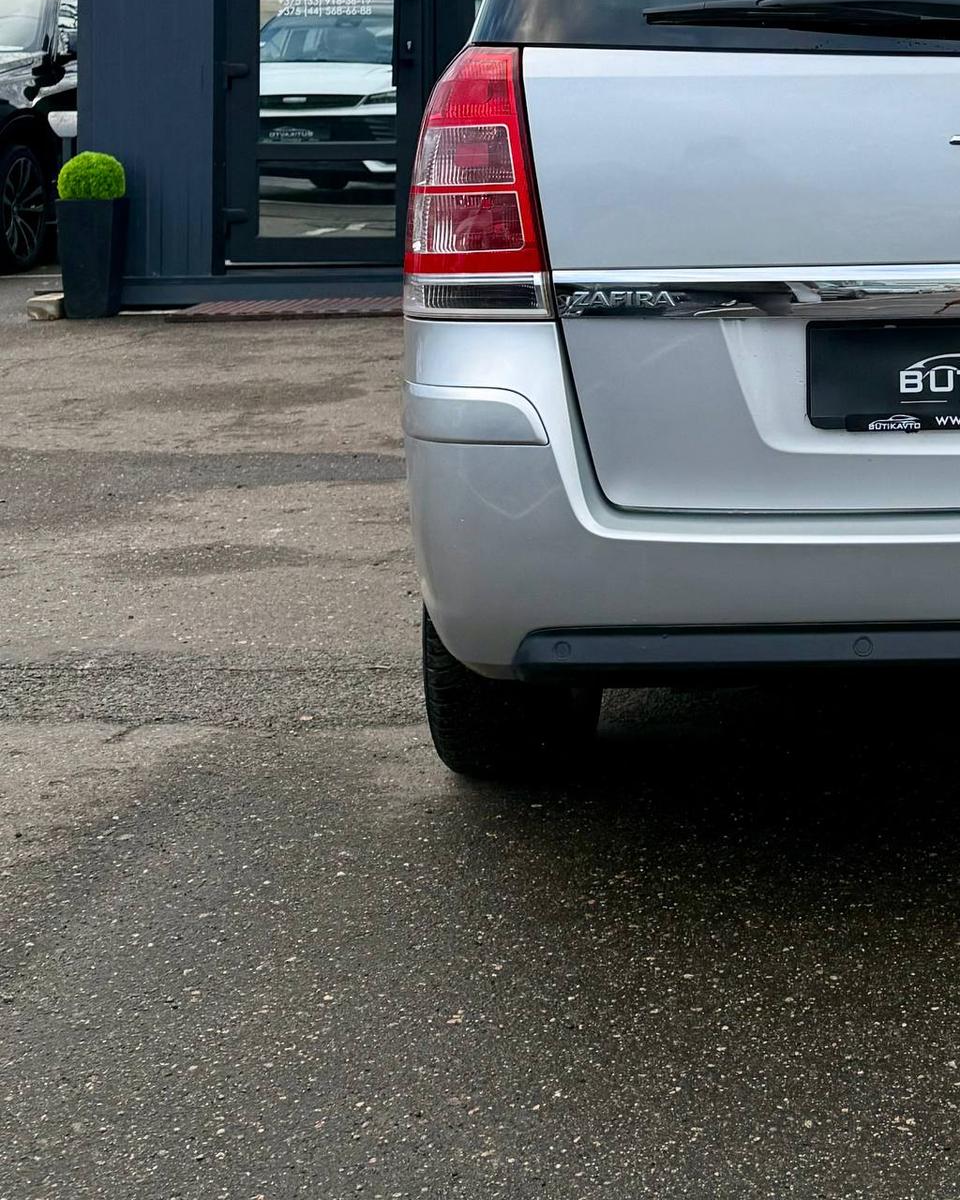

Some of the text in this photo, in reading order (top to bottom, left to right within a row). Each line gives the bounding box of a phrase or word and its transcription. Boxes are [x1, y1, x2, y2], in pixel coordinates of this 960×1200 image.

[304, 6, 322, 17] (44)
[570, 290, 676, 308] ZAFIRA
[868, 422, 921, 430] BUTIKAVTO
